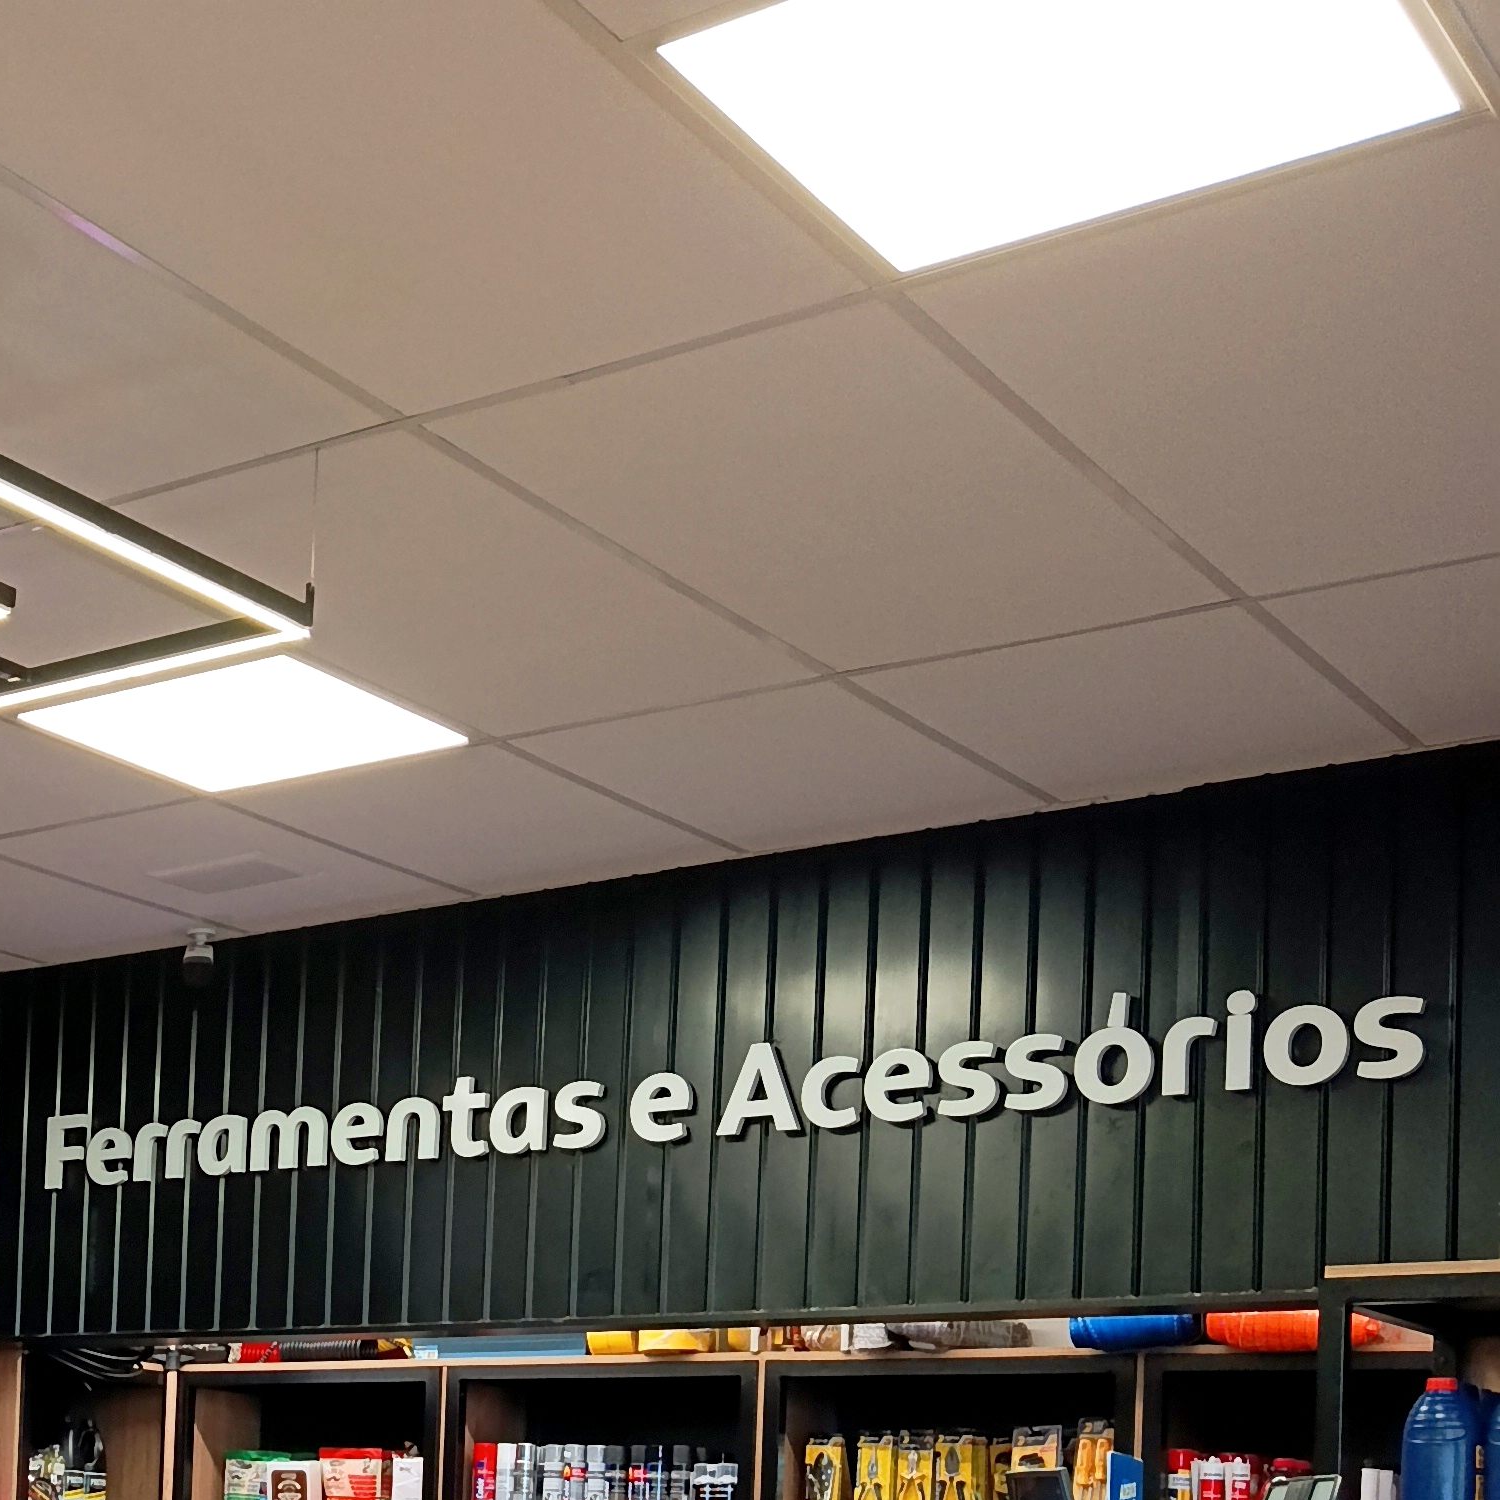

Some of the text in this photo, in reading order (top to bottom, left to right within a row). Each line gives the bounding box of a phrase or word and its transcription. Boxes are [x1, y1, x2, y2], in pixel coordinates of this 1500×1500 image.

[45, 990, 1426, 1190] Ferramentas e Acessórios
